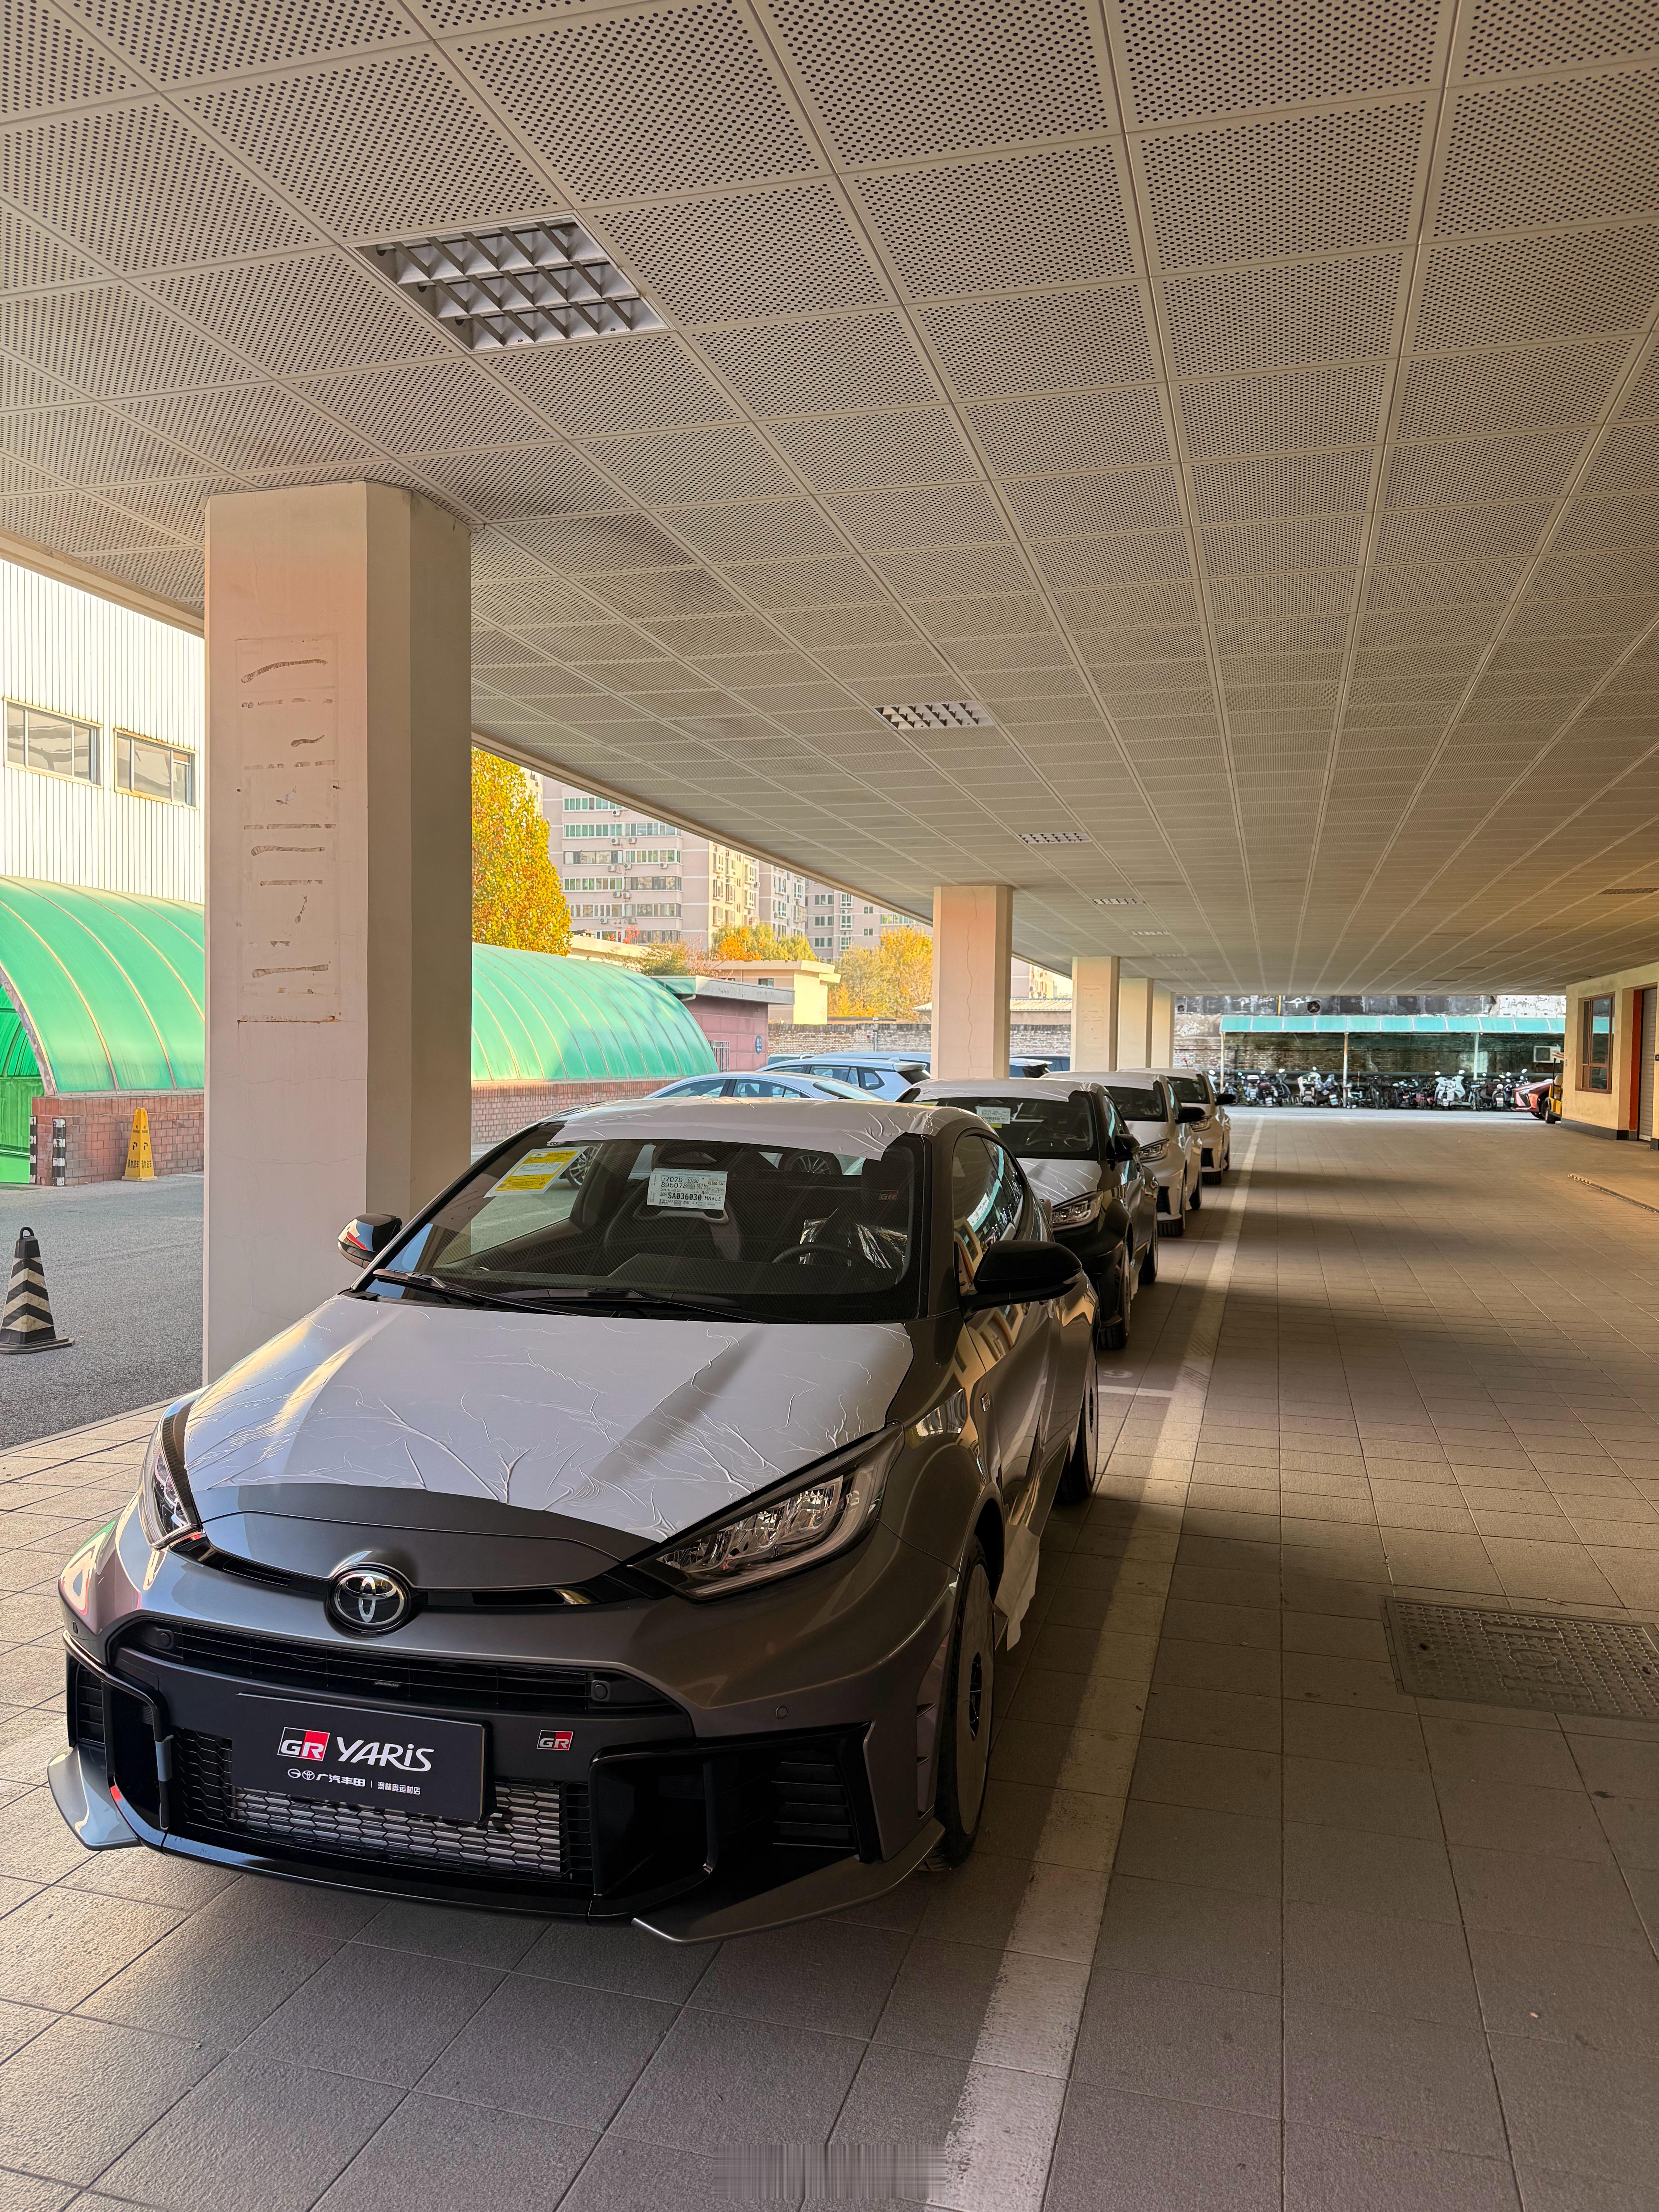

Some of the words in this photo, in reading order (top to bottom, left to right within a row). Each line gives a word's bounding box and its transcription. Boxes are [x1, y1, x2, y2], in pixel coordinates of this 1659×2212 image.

[668, 1192, 702, 1200] SA036030
[316, 1773, 366, 1787] 广汽丰田
